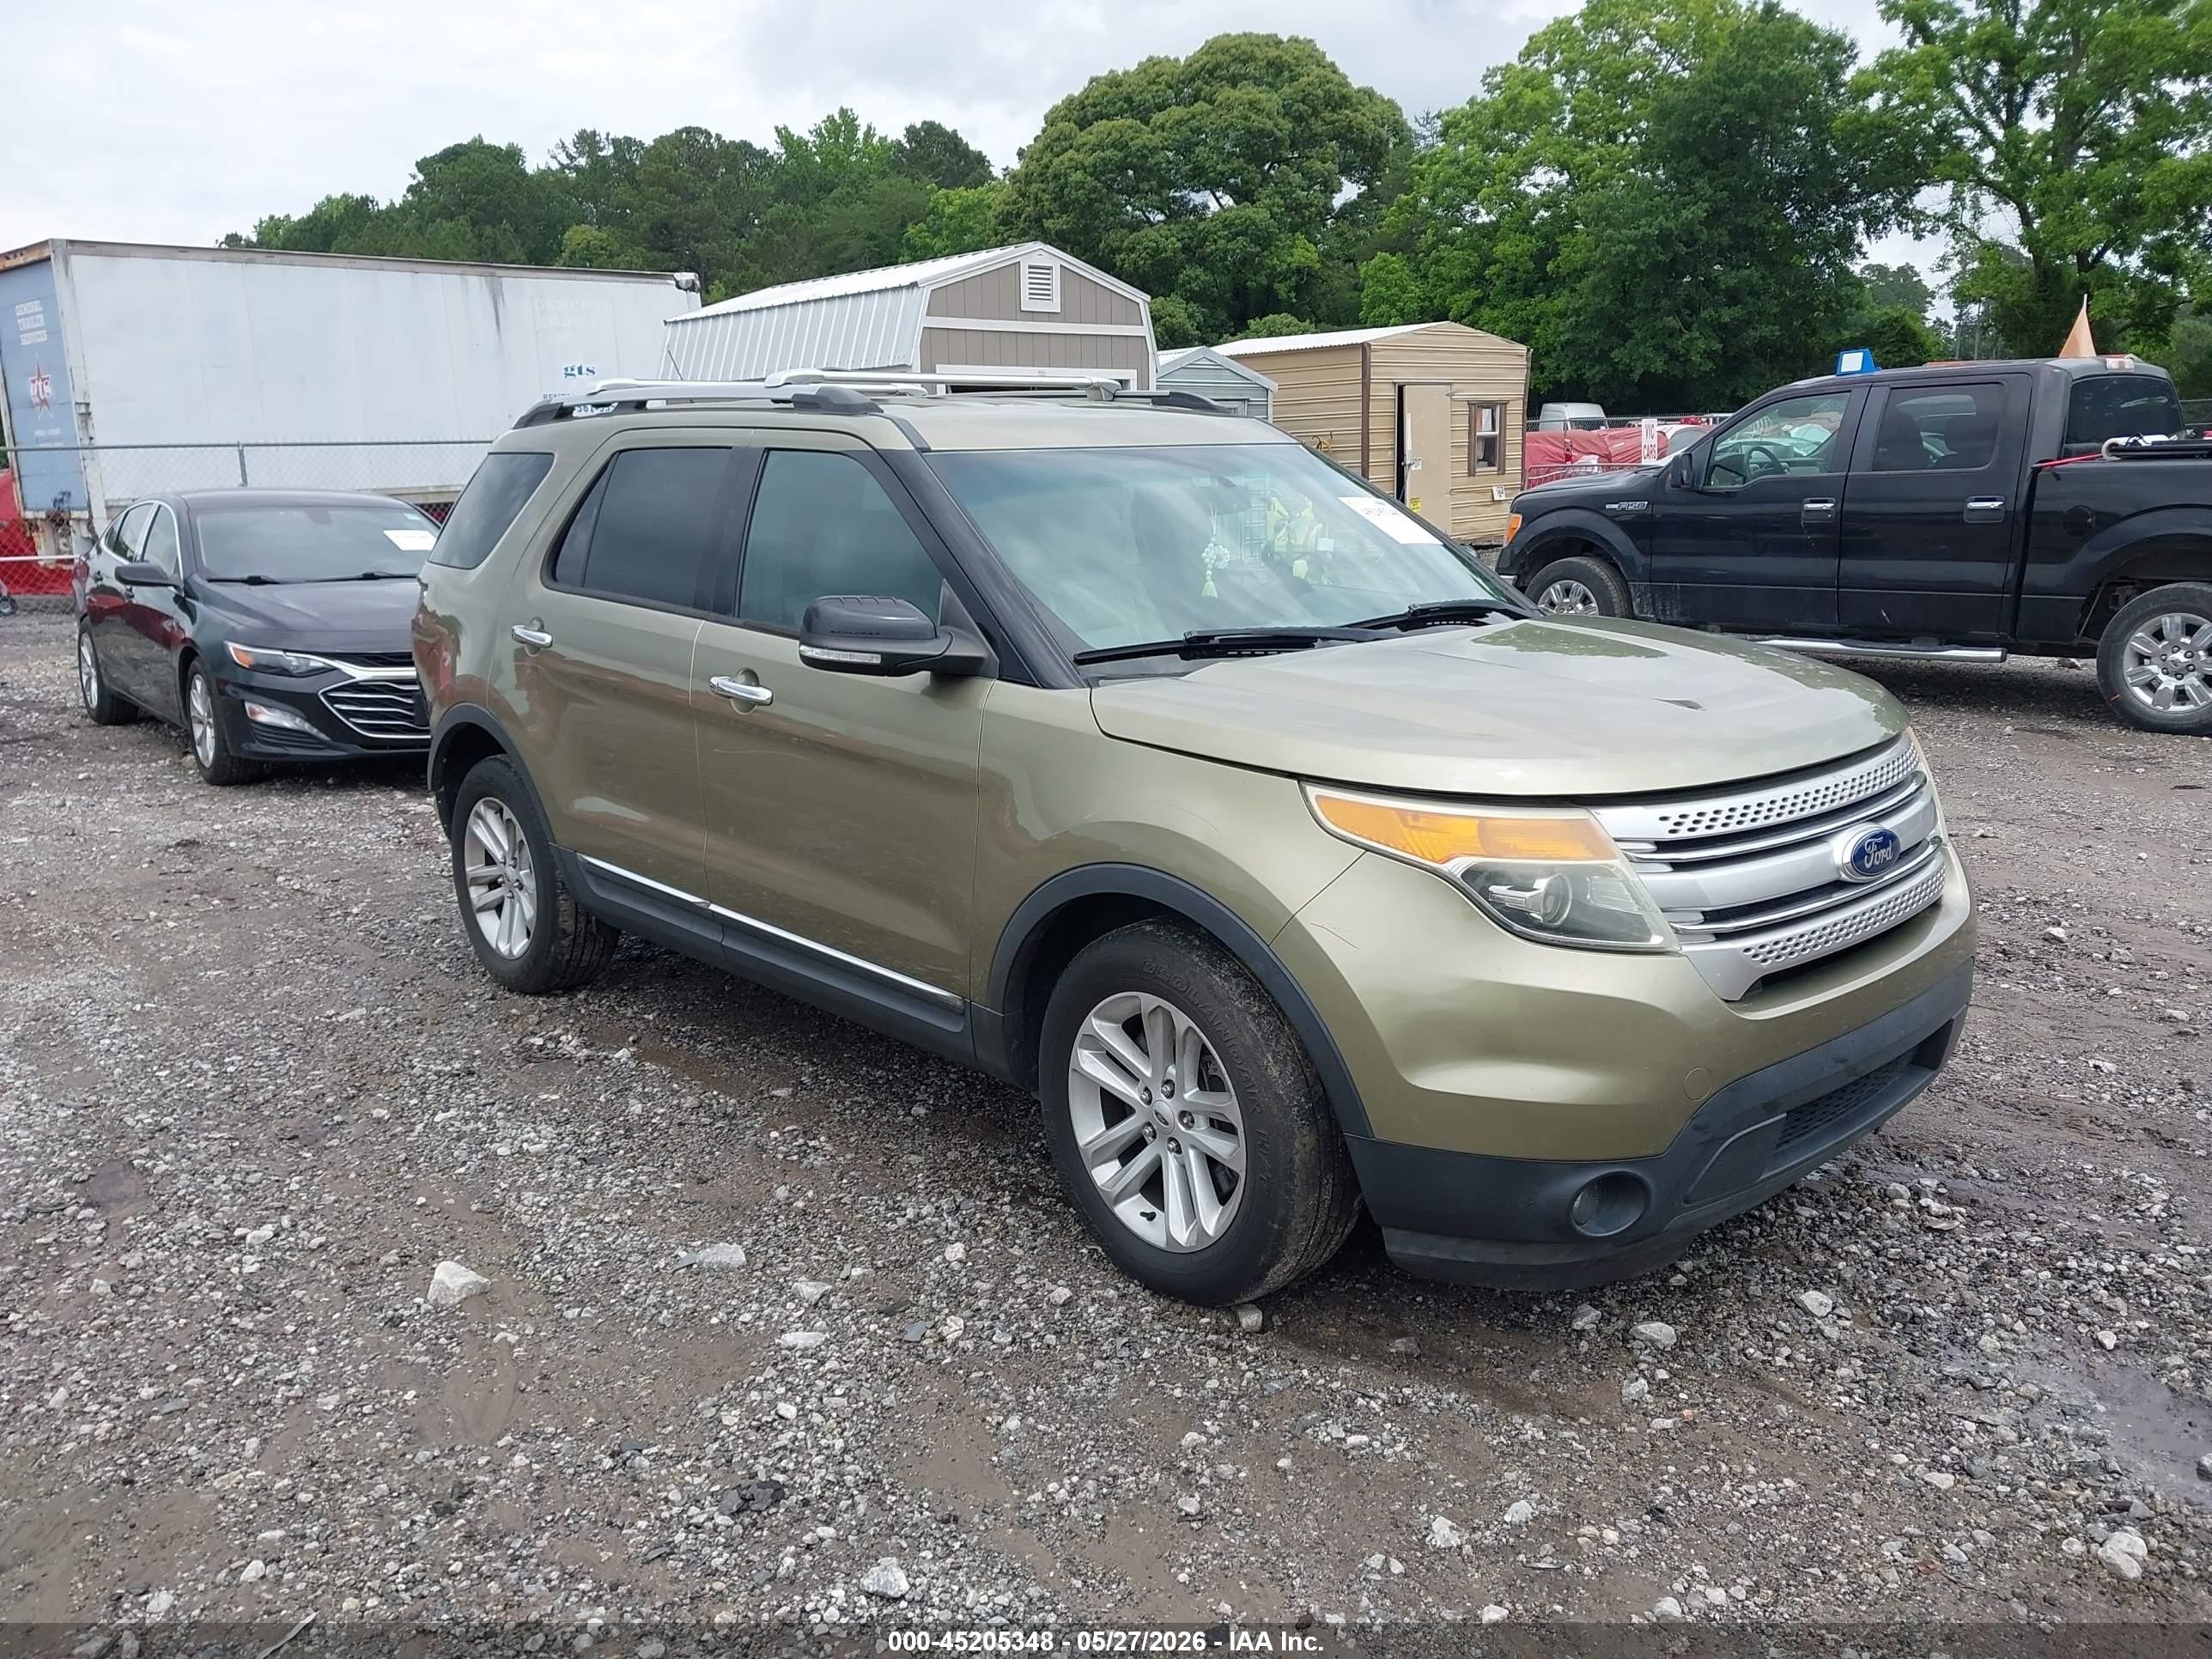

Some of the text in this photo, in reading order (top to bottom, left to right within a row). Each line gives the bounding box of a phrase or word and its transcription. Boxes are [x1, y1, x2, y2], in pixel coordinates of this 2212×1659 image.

[563, 364, 596, 379] gts
[1644, 423, 1655, 441] VIC
[1643, 443, 1656, 460] CARS
[1865, 836, 1893, 868] Ford
